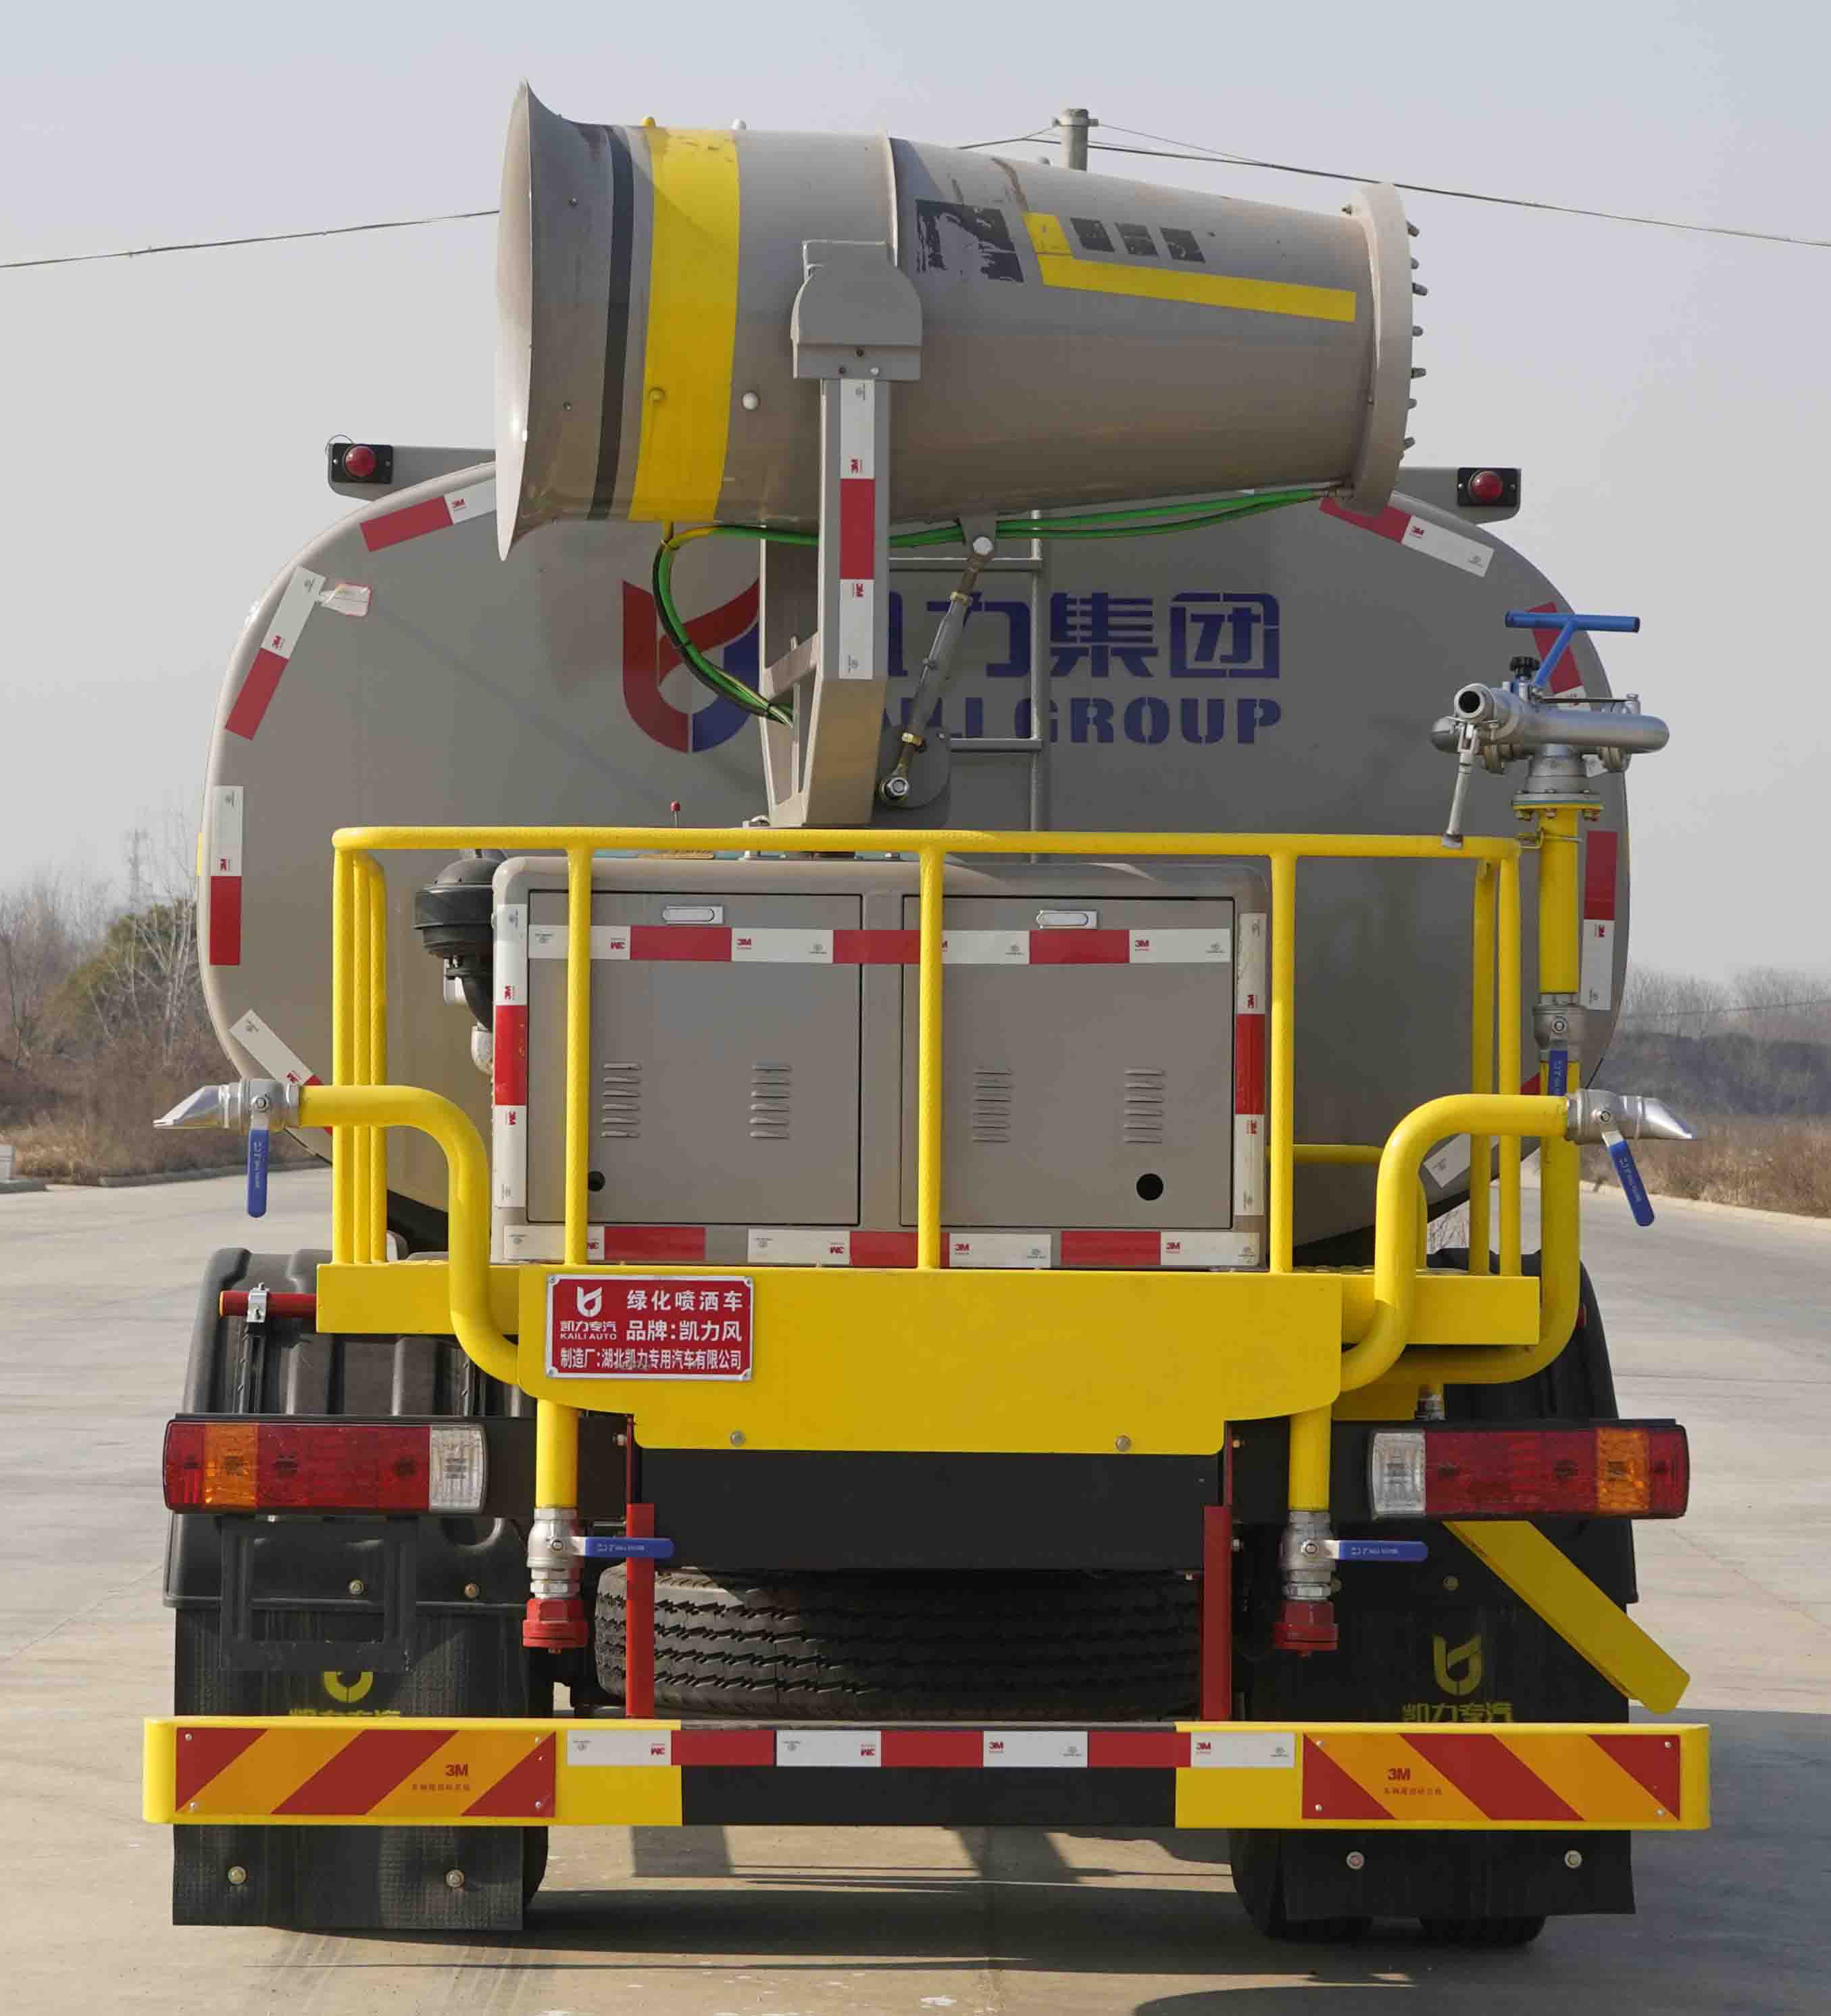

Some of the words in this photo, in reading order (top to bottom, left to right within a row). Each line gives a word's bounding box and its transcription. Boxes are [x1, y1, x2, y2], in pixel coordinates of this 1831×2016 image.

[850, 458, 861, 473] 3M
[451, 498, 466, 508] 3M
[855, 583, 864, 597] 3M
[886, 589, 1280, 679] 力集团
[1014, 697, 1282, 744] GROUP
[220, 858, 228, 872] 3M
[1599, 925, 1607, 938] 3M
[610, 942, 626, 950] 3M
[736, 938, 752, 947] 3M
[1135, 940, 1150, 948] 3M
[503, 984, 513, 1000] 3M
[508, 1111, 516, 1125] 3M
[830, 1246, 844, 1254] 3M
[954, 1243, 970, 1251] 3M
[1165, 1241, 1180, 1249] 3M
[627, 1289, 743, 1312] 绿化喷洒车
[559, 1320, 617, 1332] 凯力专汽
[626, 1319, 743, 1342] 品牌:凯力风
[560, 1347, 742, 1370] 制造厂:湖北凯力专用汽车有限公司
[651, 1746, 666, 1755] 3M
[861, 1748, 876, 1756] 3M
[988, 1742, 1005, 1750] 3M
[1197, 1742, 1211, 1750] 3M
[445, 1763, 469, 1777] 3M
[1387, 1767, 1411, 1781] 3M
